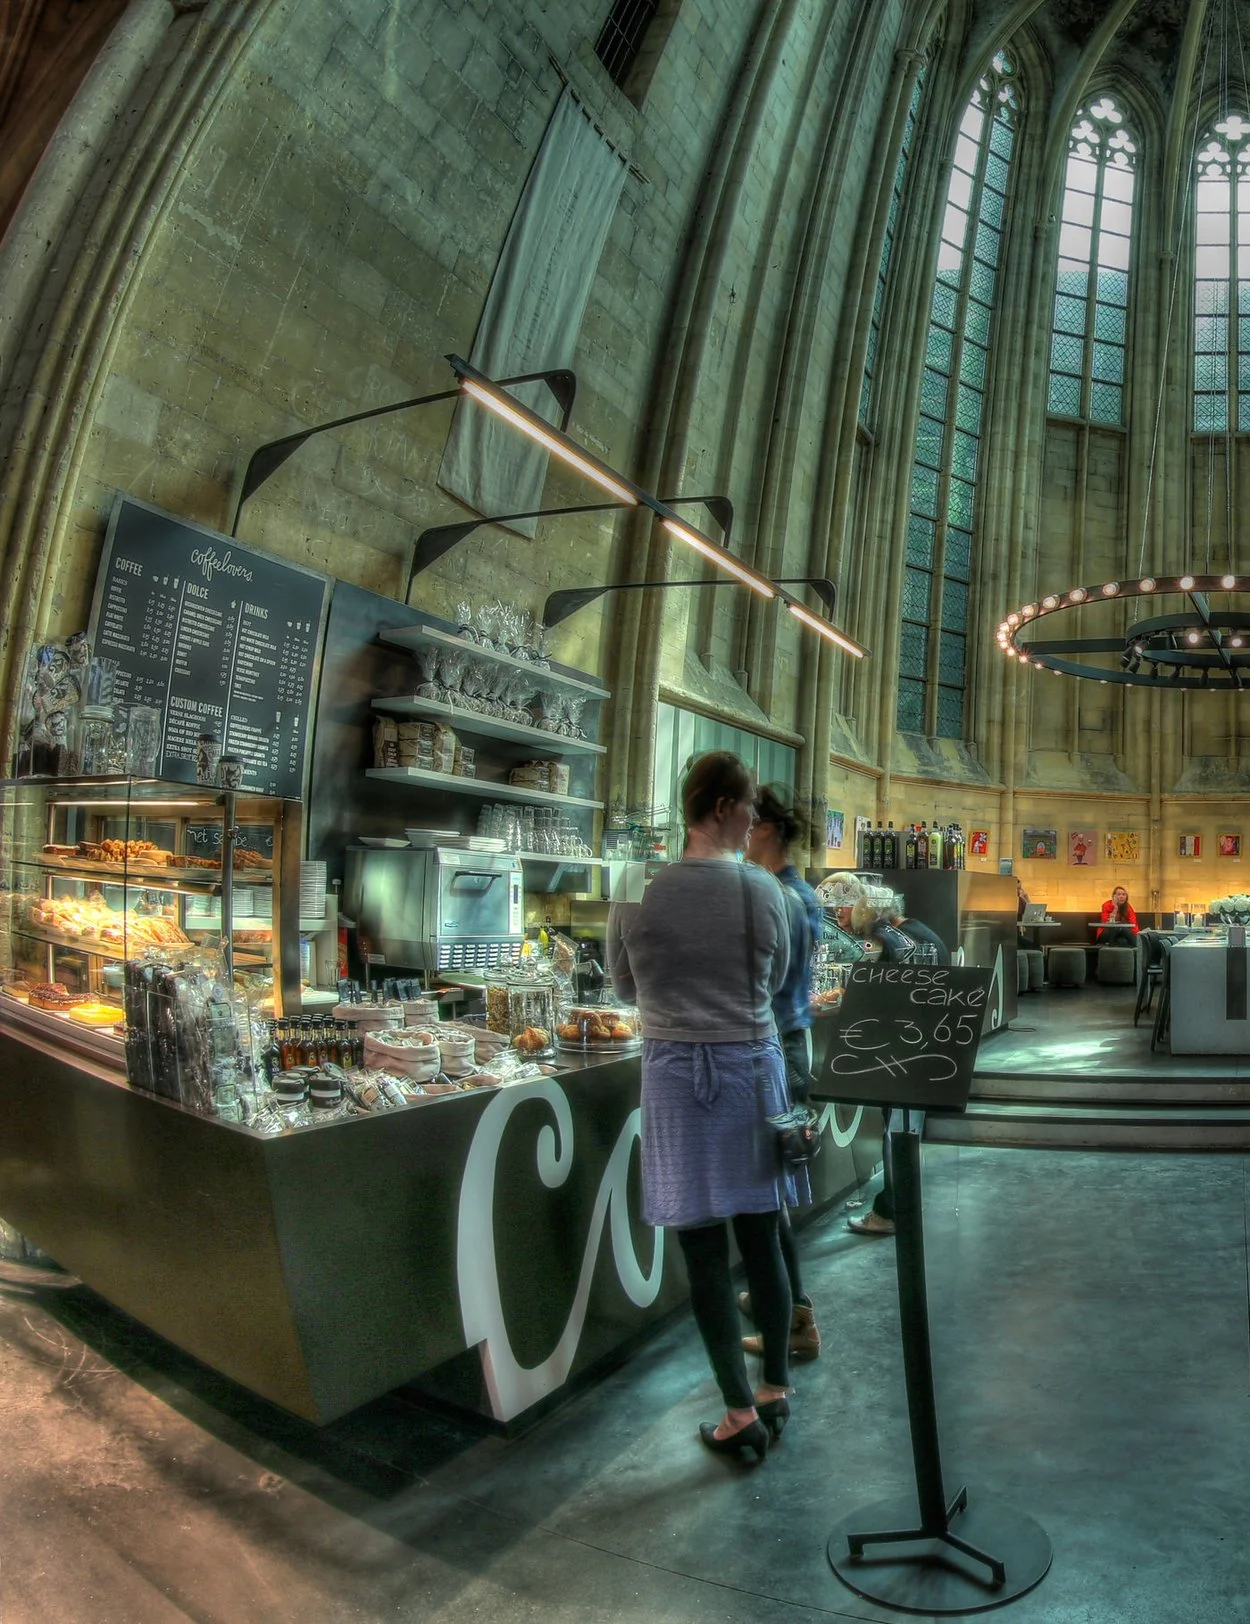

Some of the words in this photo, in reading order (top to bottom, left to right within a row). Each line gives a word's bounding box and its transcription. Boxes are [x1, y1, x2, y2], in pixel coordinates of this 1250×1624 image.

[115, 557, 143, 577] COFFEE
[187, 582, 210, 600] DOLCE
[244, 602, 269, 620] DRINKS
[170, 695, 197, 712] CUSTOM
[198, 702, 224, 718] COFFEE
[839, 1017, 891, 1050] €
[893, 1013, 979, 1050] 3,65
